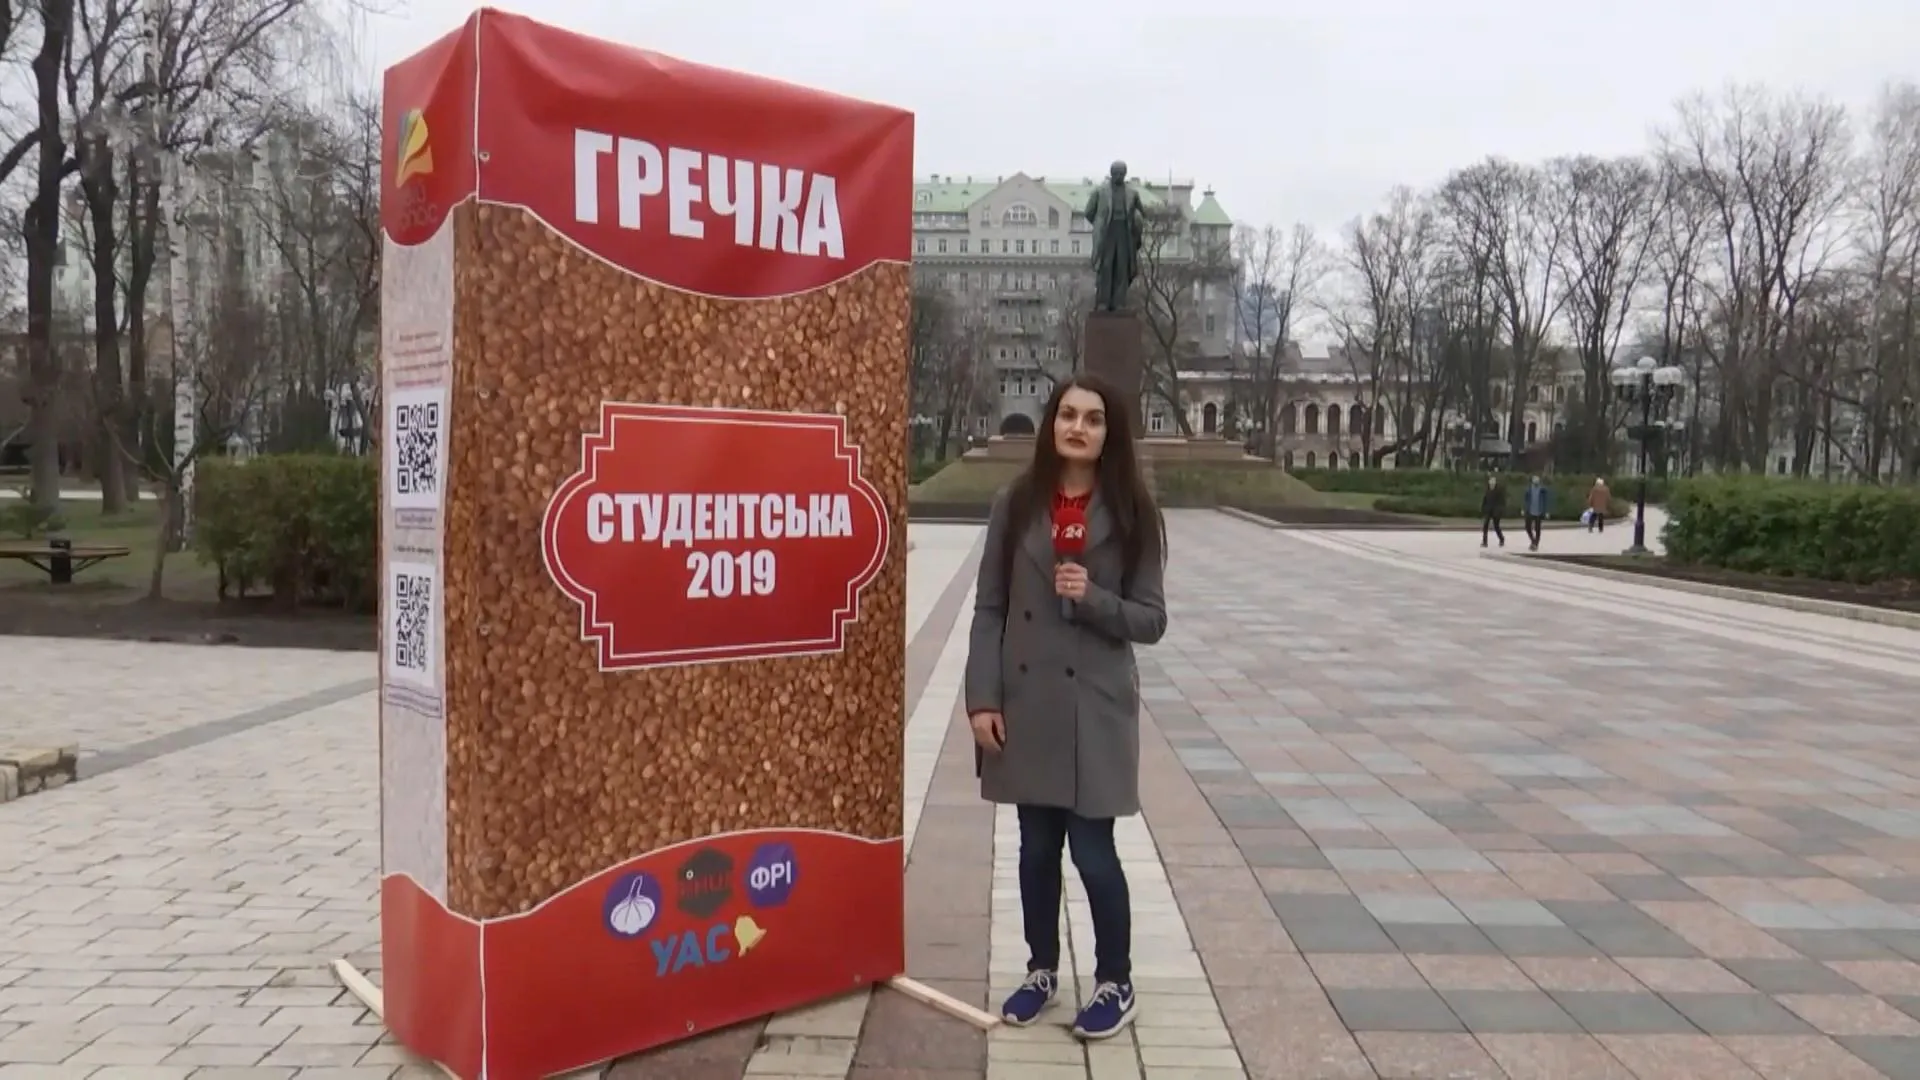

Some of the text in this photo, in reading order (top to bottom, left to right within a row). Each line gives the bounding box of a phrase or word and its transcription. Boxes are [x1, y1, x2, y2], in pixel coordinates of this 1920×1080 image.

[574, 127, 845, 260] ГРЕЧКА
[586, 492, 853, 548] СТУДЕНТСЬКА
[1064, 524, 1084, 539] 24
[686, 549, 776, 599] 2019
[750, 860, 792, 891] ФРІ
[650, 922, 731, 978] УАС
